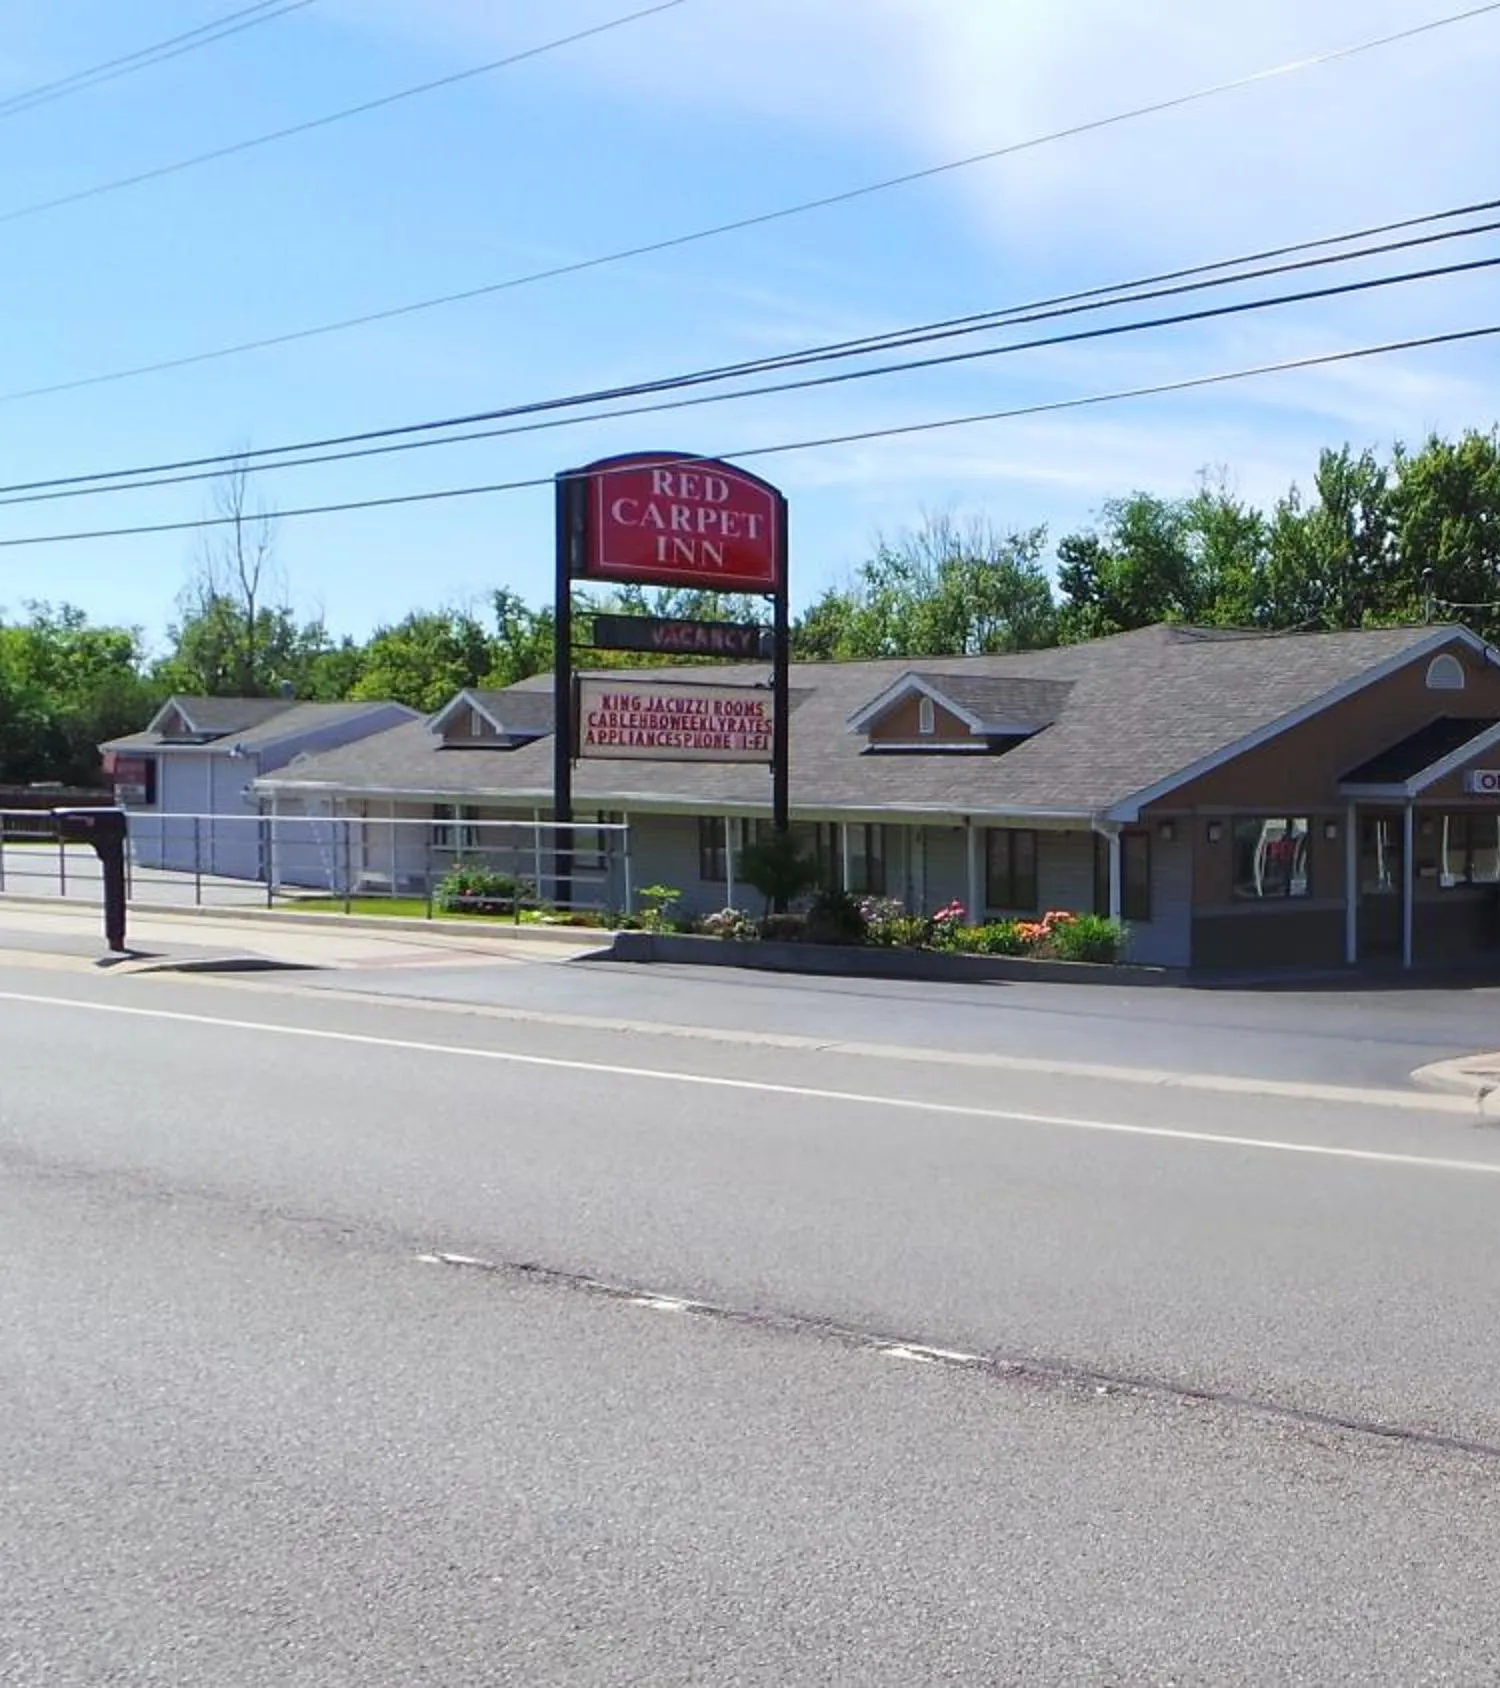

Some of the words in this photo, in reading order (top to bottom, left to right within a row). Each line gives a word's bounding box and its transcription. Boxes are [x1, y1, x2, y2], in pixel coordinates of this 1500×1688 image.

[652, 469, 729, 503] RED
[611, 498, 763, 540] CARPET
[657, 535, 724, 567] INN
[652, 625, 750, 650] VACANCY
[602, 693, 641, 712] KING
[645, 698, 709, 714] JACUZZI
[714, 701, 764, 717] ROOMS
